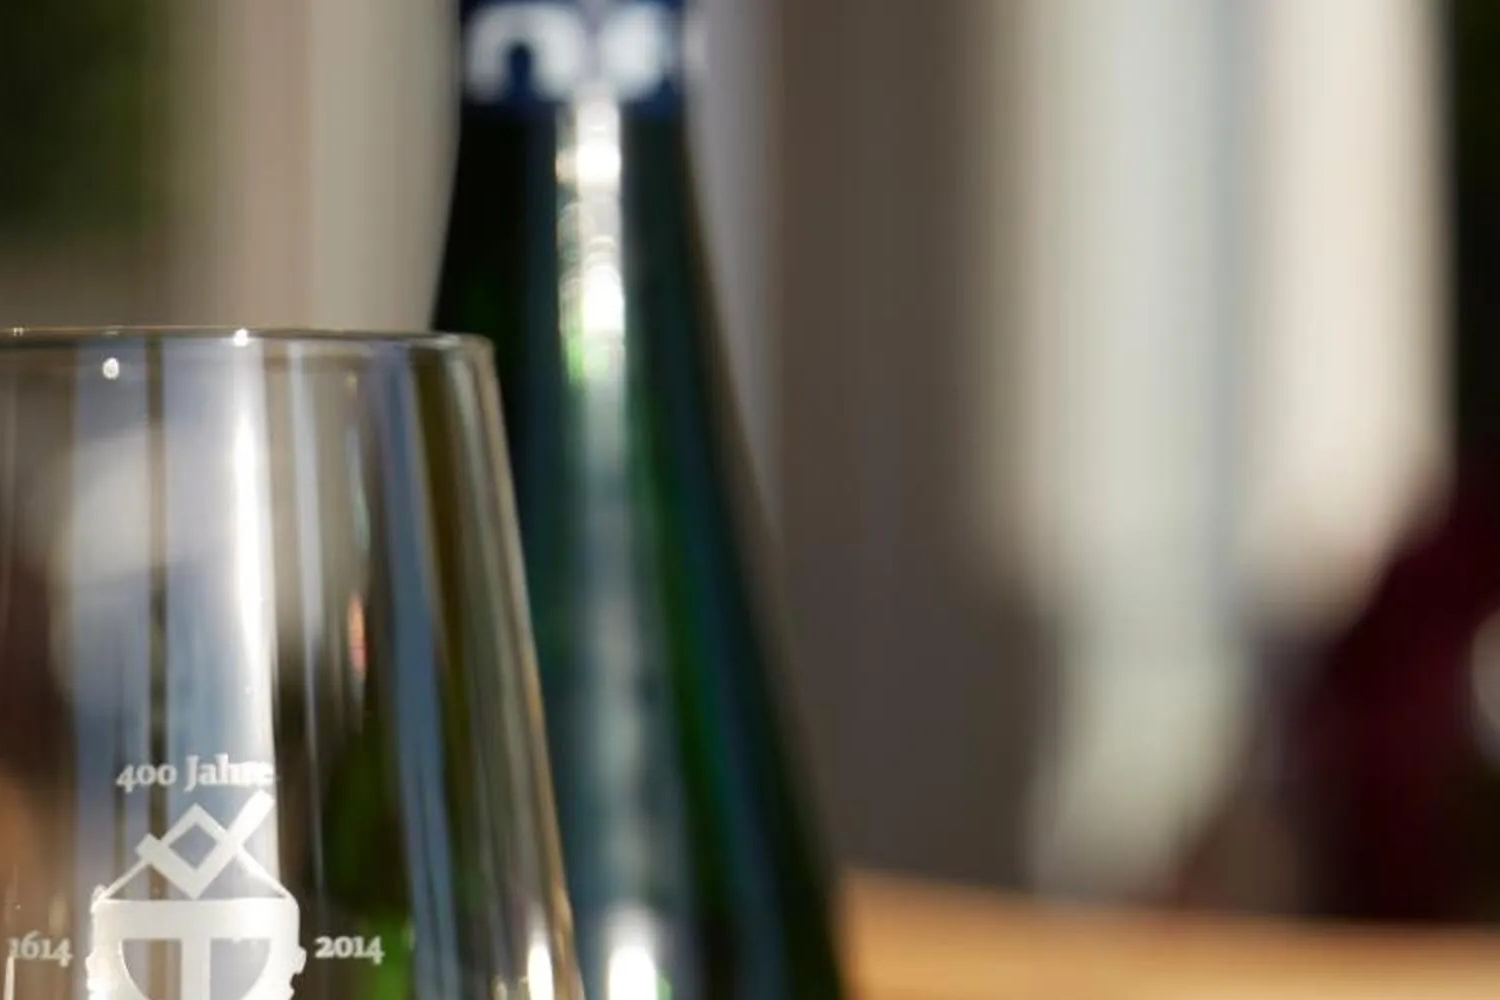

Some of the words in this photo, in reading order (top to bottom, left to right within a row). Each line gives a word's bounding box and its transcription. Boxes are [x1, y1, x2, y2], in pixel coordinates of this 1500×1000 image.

[116, 763, 177, 793] 400
[7, 929, 73, 967] 1614
[315, 935, 385, 966] 2014
